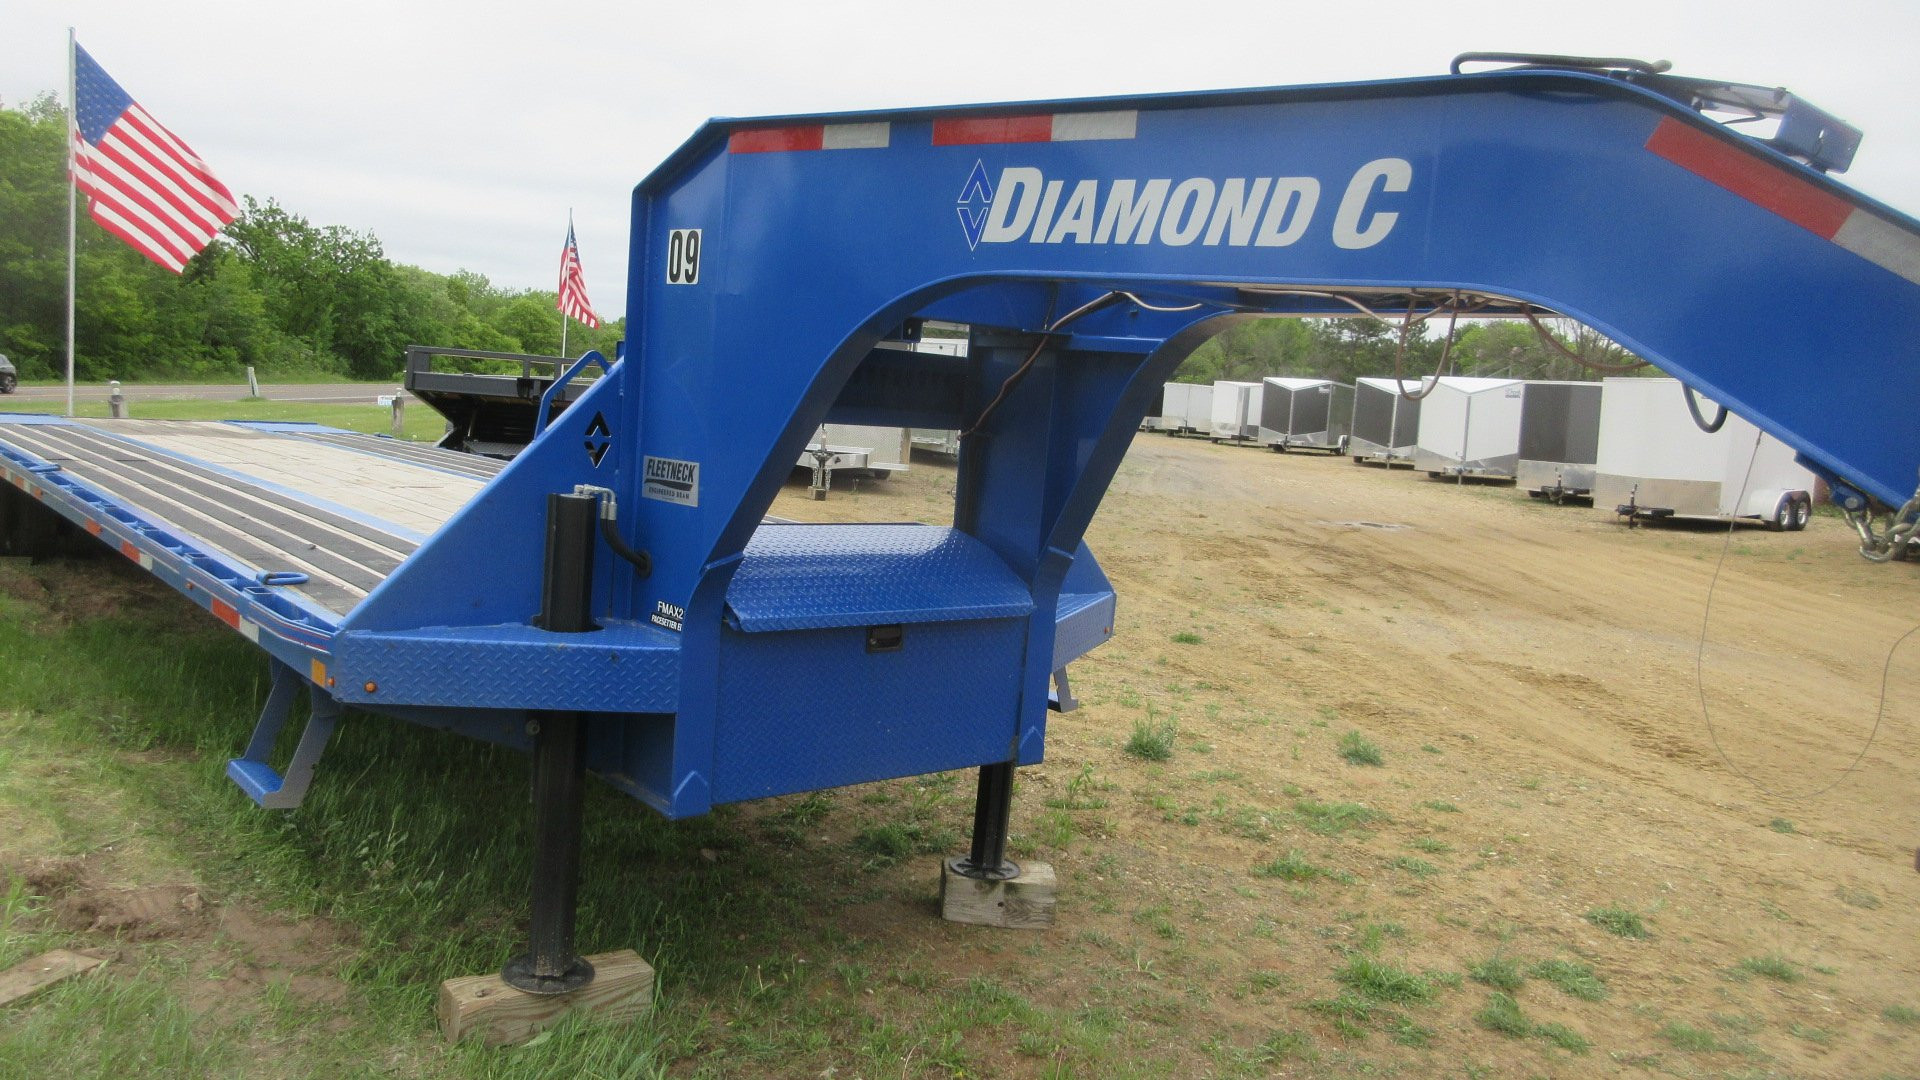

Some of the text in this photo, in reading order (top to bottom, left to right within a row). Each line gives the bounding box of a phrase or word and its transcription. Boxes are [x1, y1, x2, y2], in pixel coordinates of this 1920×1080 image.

[981, 158, 1413, 250] DIAMOND C
[669, 230, 700, 283] 09
[646, 458, 696, 483] FLEETNECK
[651, 614, 677, 630] PACESETTER
